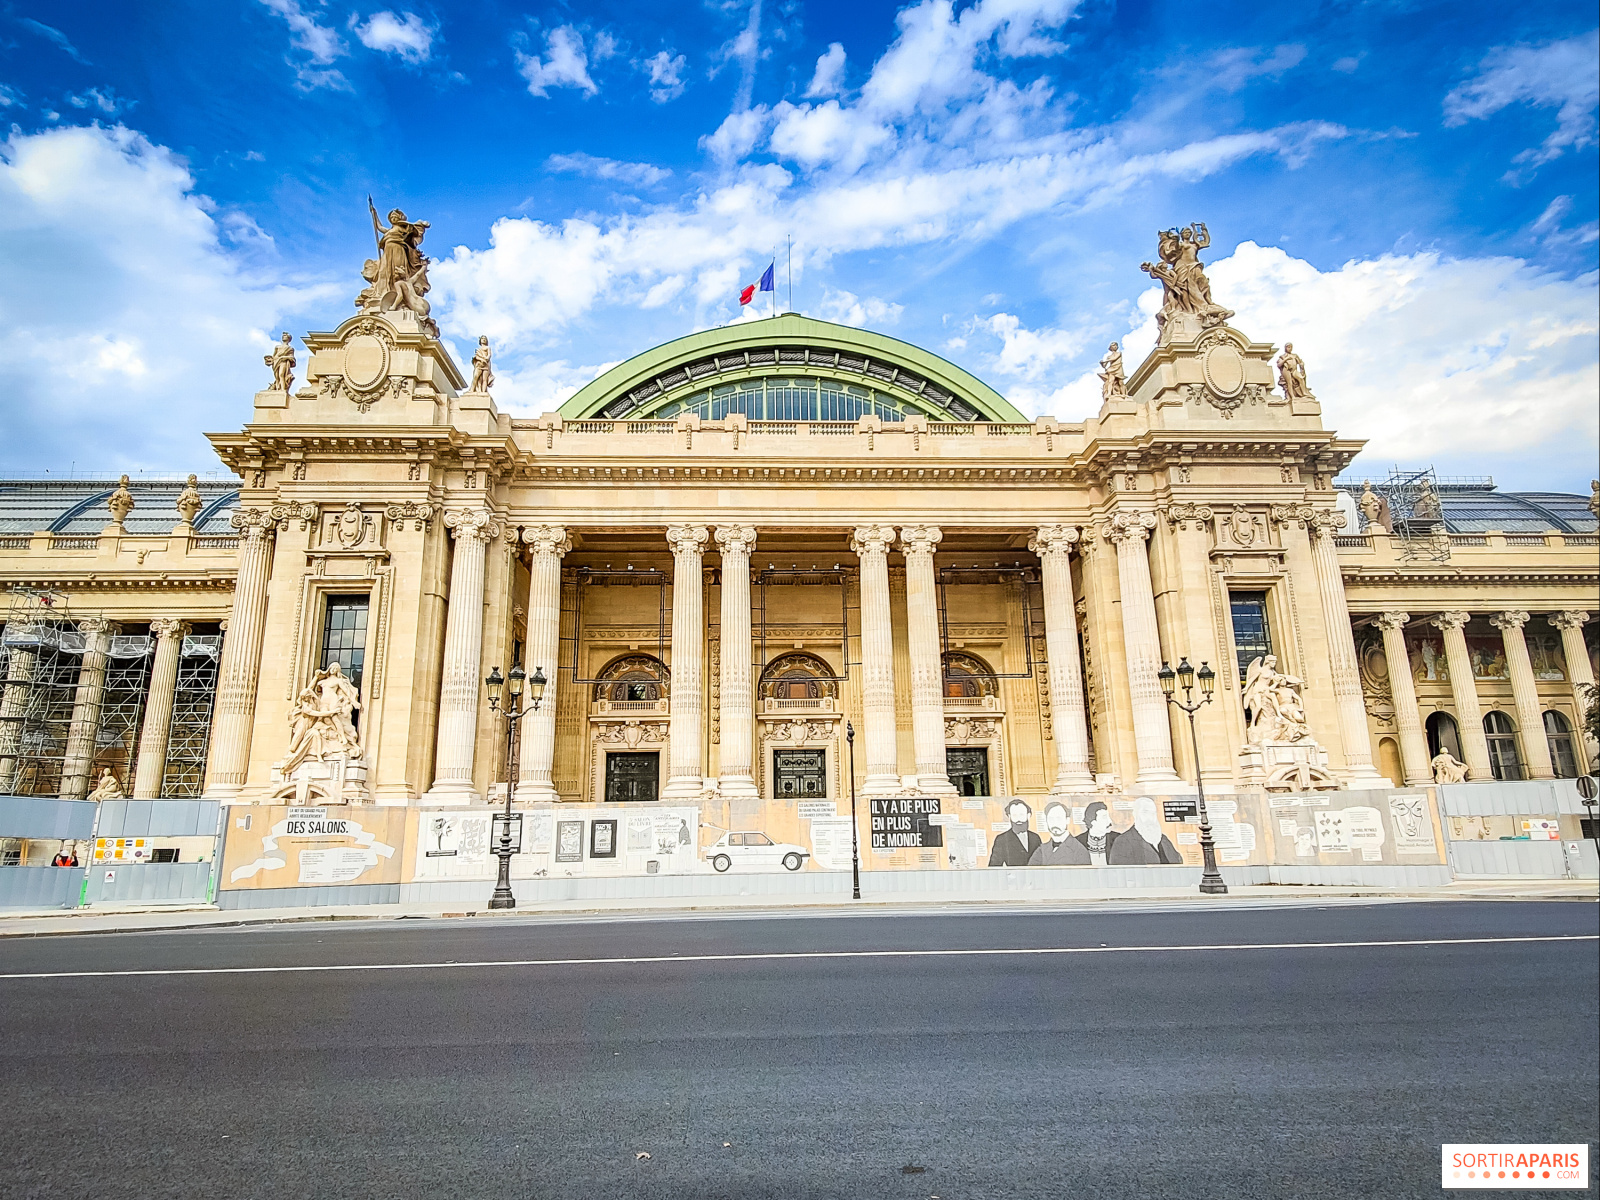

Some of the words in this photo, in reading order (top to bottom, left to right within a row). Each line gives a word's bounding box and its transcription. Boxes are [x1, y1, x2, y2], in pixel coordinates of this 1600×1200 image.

[871, 800, 880, 814] IL
[881, 800, 888, 814] Y
[890, 800, 898, 814] A
[900, 800, 913, 814] DE
[915, 800, 939, 814] PLUS
[287, 821, 306, 834] DES
[308, 821, 349, 834] SALONS.
[872, 816, 884, 830] EN
[887, 816, 912, 830] PLUS
[873, 833, 885, 847] DE
[887, 833, 923, 847] MONDE
